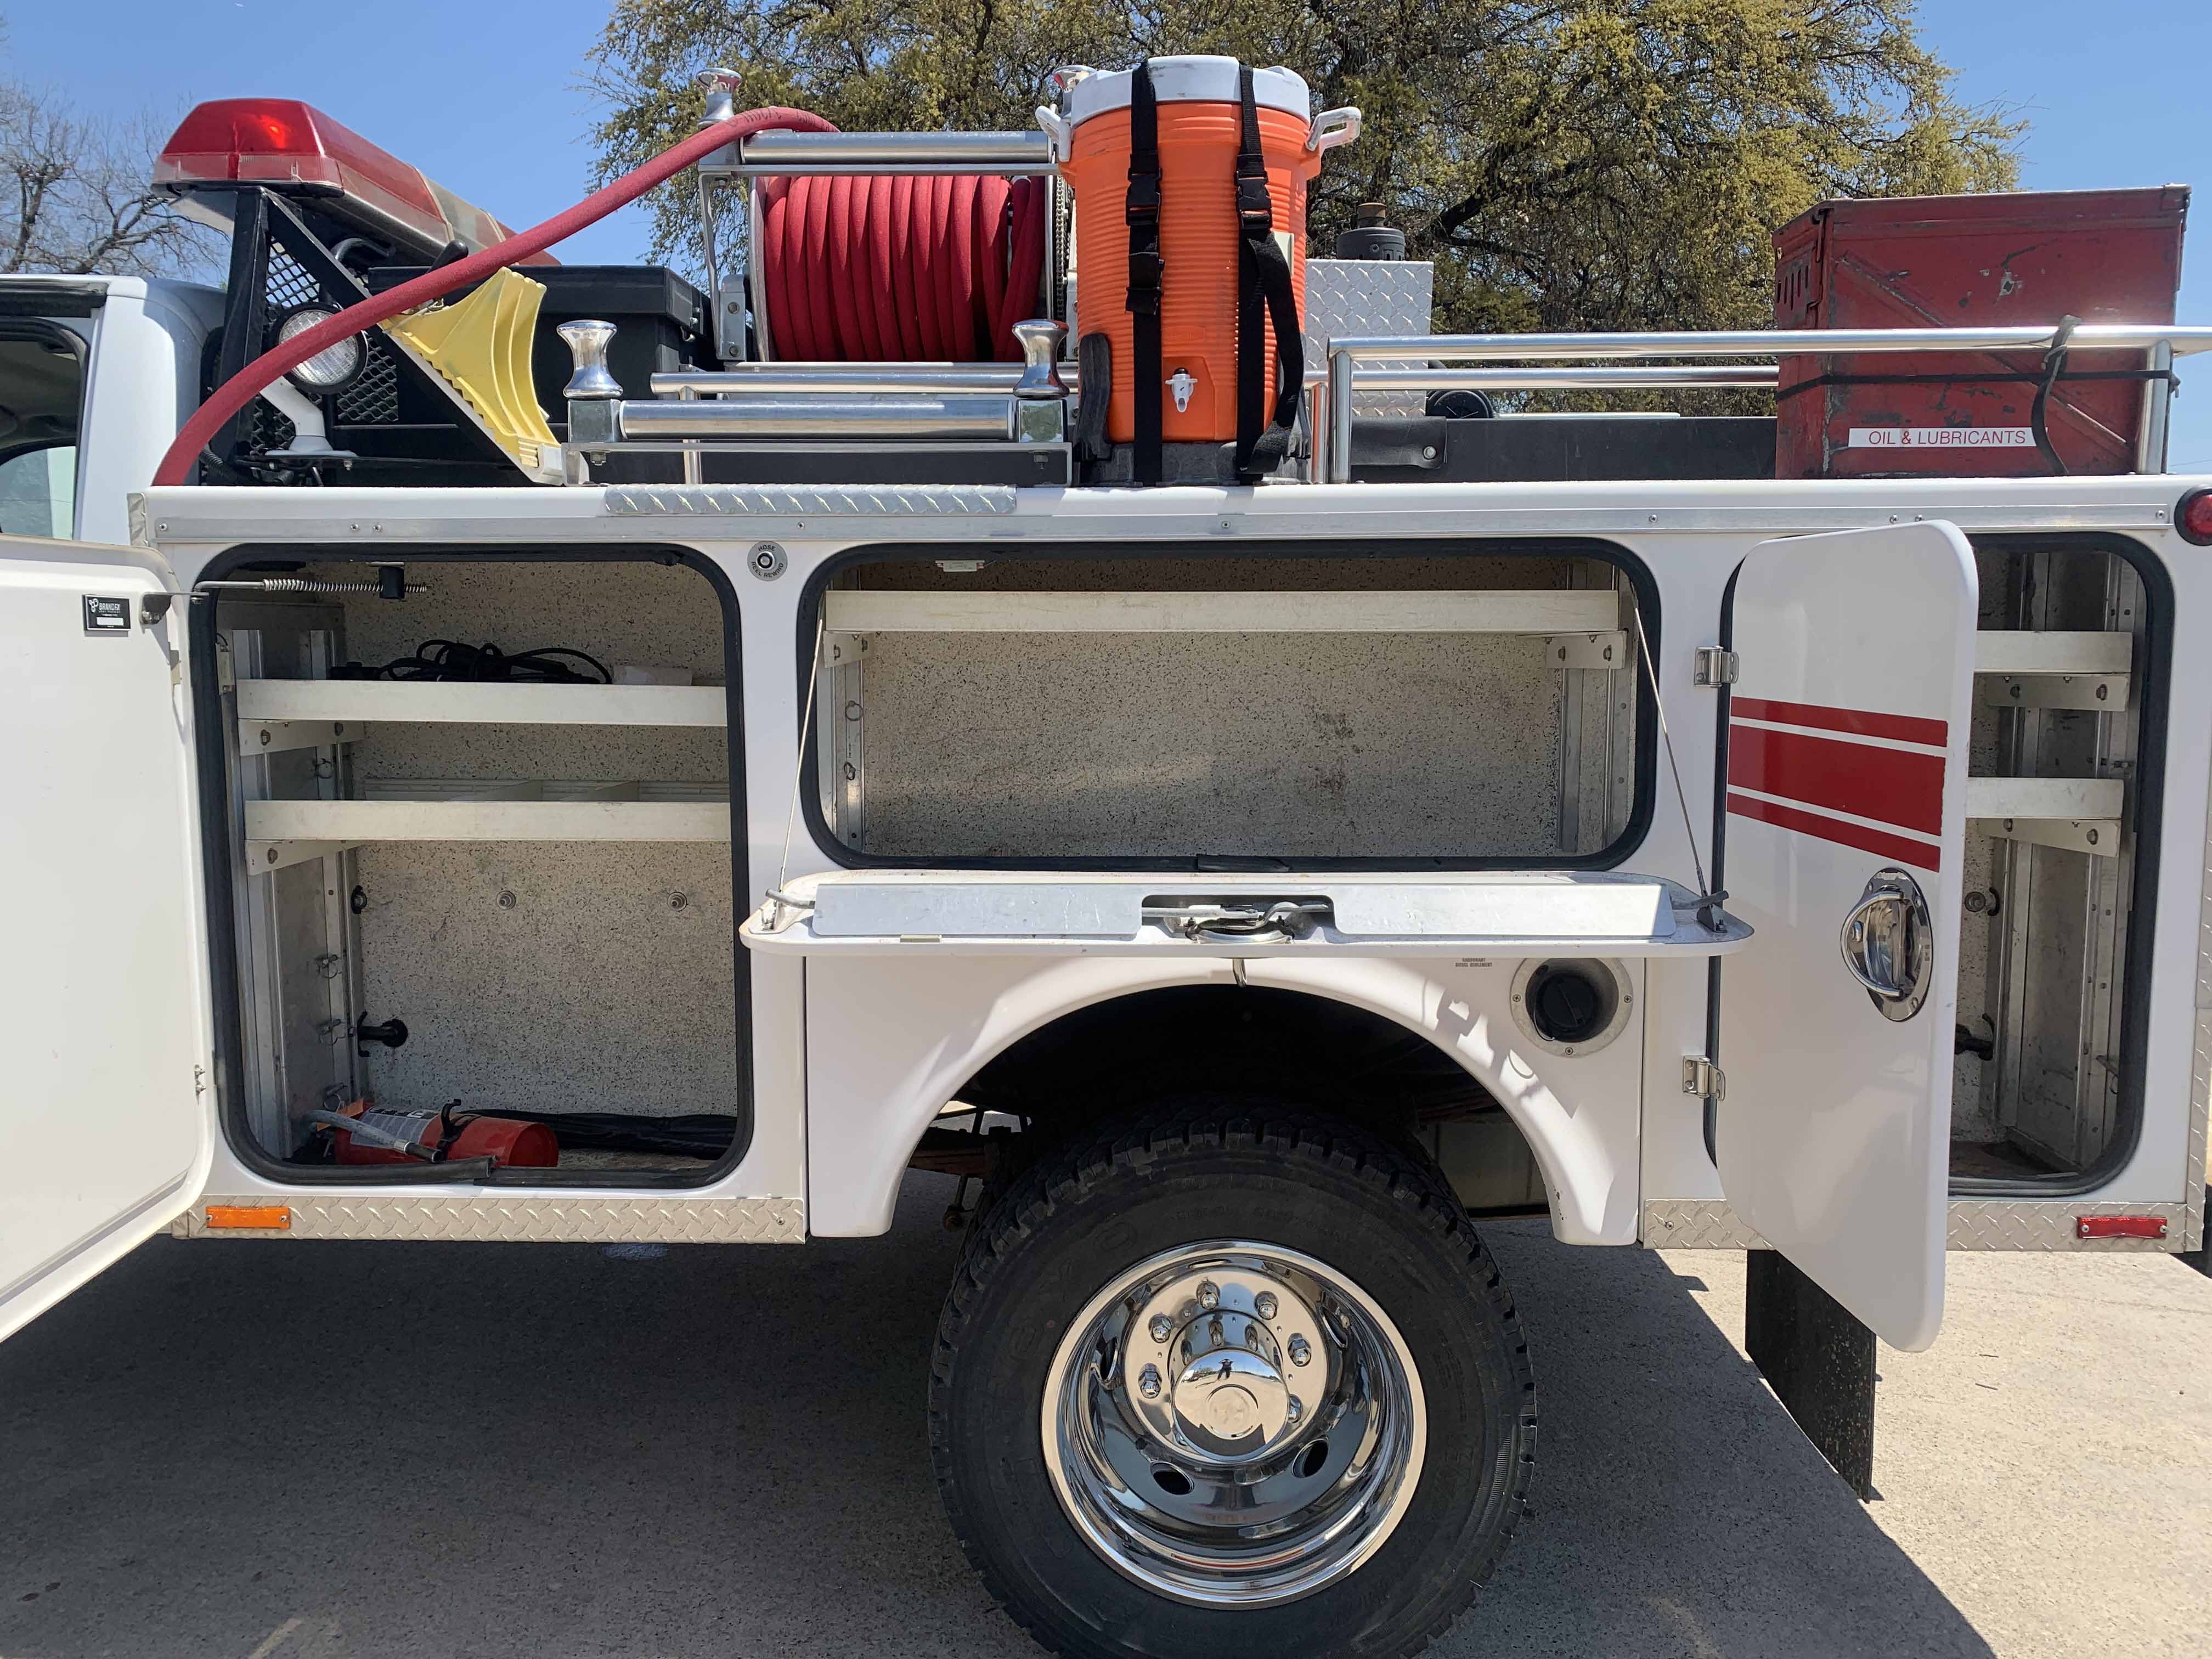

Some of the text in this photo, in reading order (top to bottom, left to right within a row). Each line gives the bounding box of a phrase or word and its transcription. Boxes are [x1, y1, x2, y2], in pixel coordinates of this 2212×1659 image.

[1869, 430, 2026, 444] OIL & LUBRICANTS
[751, 561, 784, 578] REEL REWIND
